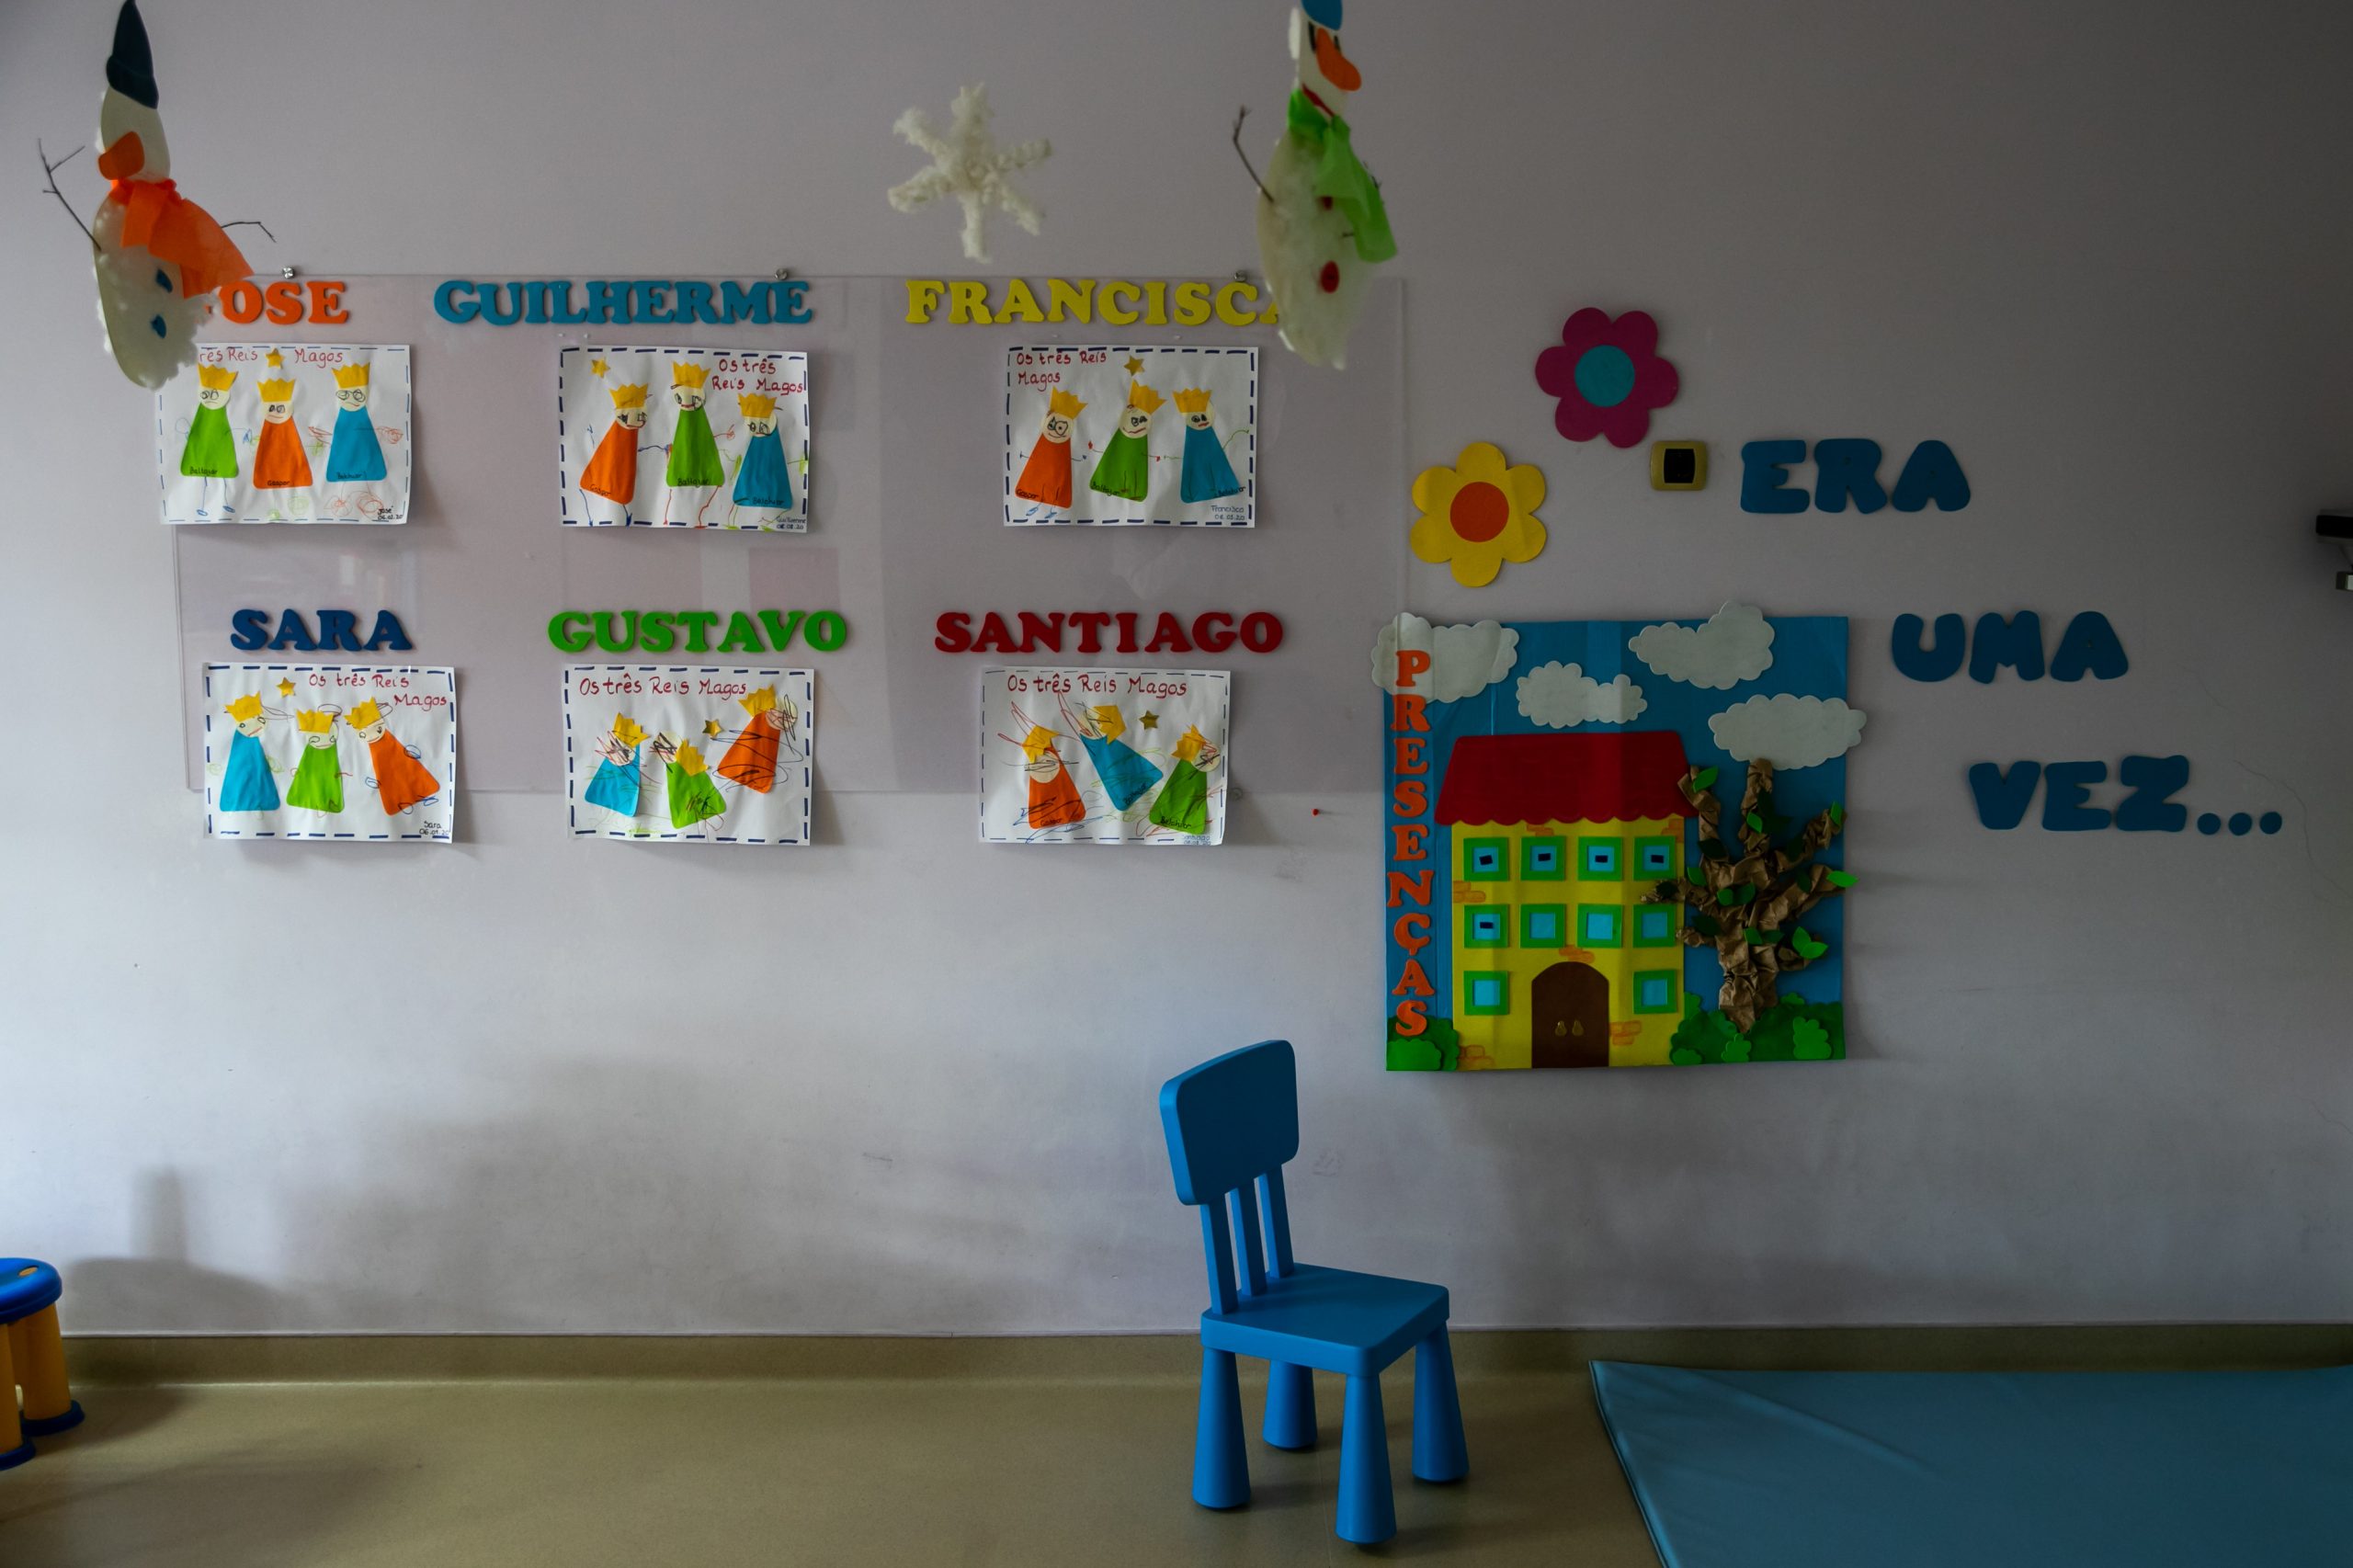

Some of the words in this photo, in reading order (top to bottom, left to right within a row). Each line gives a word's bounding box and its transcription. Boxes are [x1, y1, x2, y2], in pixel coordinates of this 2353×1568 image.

[206, 280, 349, 324] OSE
[434, 278, 813, 325] GUILHERME
[199, 347, 223, 363] rês
[227, 347, 258, 362] Reis
[294, 347, 344, 369] Magos
[719, 358, 738, 372] Os
[743, 358, 777, 375] três
[1016, 351, 1033, 366] Os
[1038, 349, 1073, 366] três
[1079, 350, 1107, 365] Reis
[711, 375, 745, 391] Reis
[756, 377, 803, 396] Magos
[1017, 369, 1061, 392] Magos
[1741, 437, 1971, 514] ERA
[230, 608, 413, 652] SARA
[548, 610, 847, 653] GUSTAVO
[934, 611, 1284, 653] SANTIAGO
[1892, 609, 2129, 684] UMA
[309, 673, 328, 688] Os
[335, 671, 367, 689] três
[372, 673, 410, 690] Reis
[579, 676, 600, 696] Os
[602, 672, 642, 695] três
[649, 676, 689, 696] Reis
[698, 678, 747, 701] Magos
[1007, 675, 1028, 692] Os
[1033, 673, 1071, 693] três
[1077, 675, 1117, 693] Reis
[1127, 676, 1188, 699] Magos
[393, 692, 449, 712] Magos
[1968, 754, 2283, 834] VEZ...
[1387, 649, 1436, 1037] PRESENÇAS
